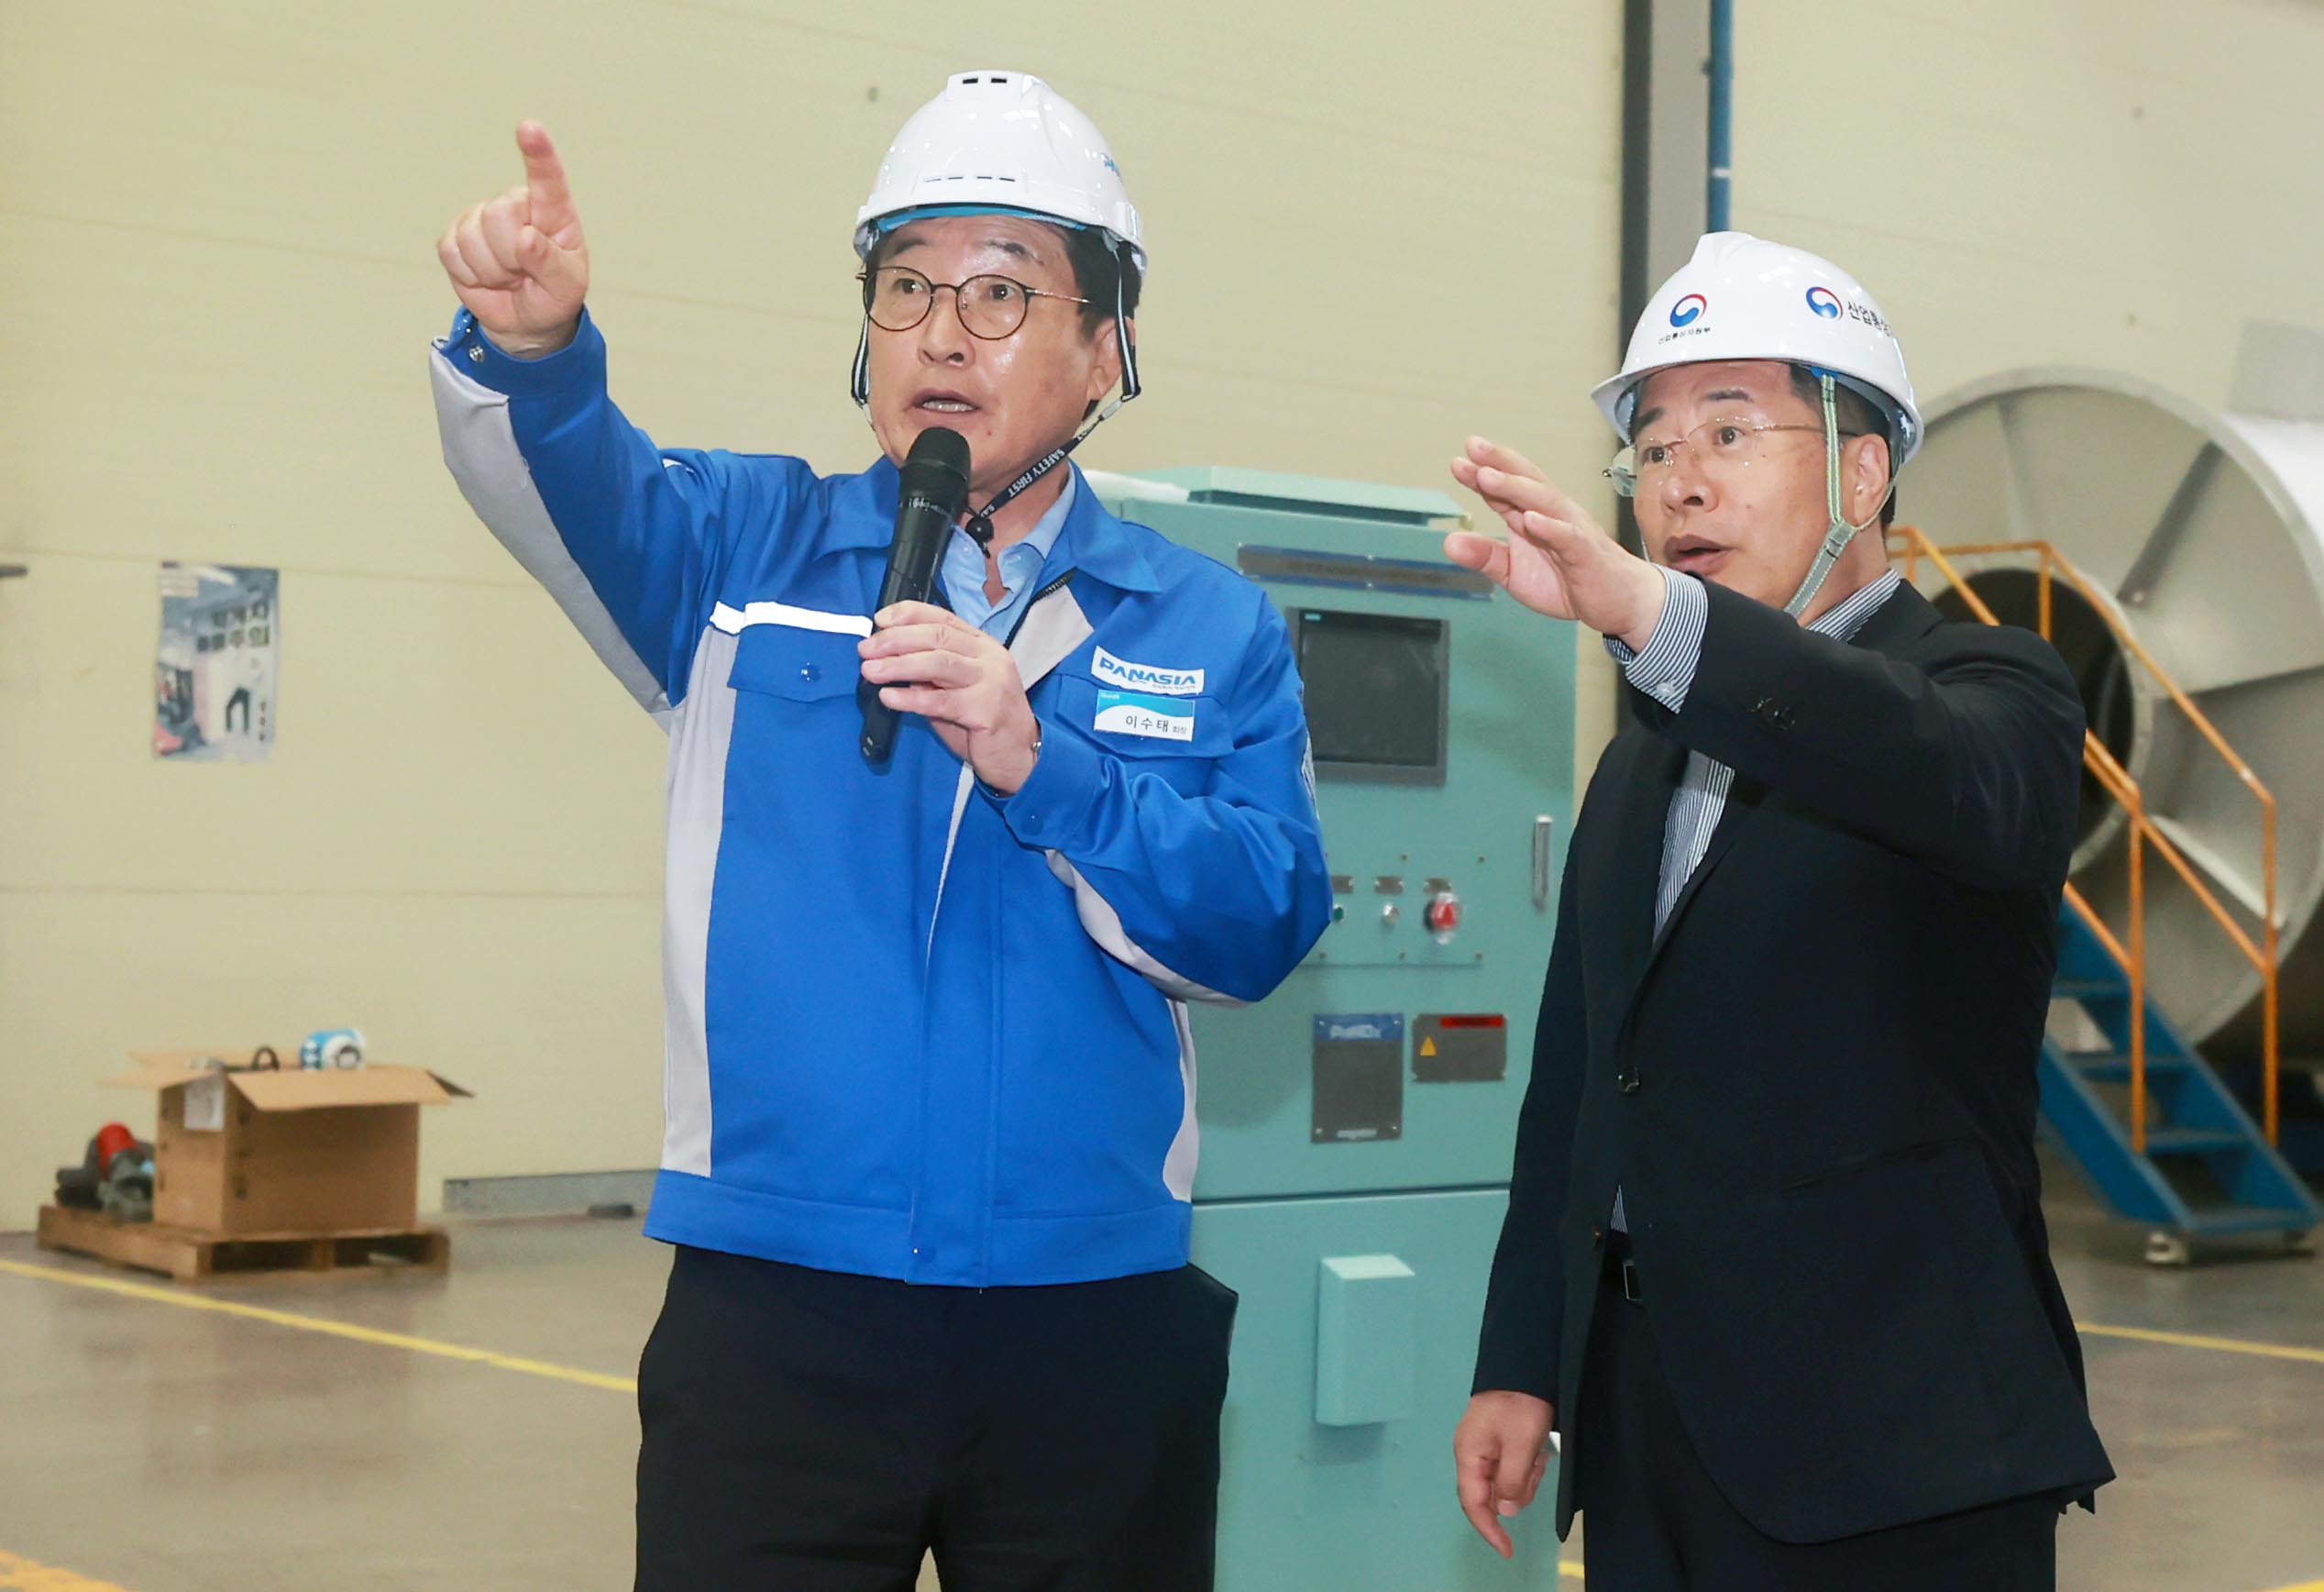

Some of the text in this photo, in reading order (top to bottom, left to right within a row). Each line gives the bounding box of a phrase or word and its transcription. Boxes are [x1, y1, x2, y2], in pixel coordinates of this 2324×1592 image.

[1008, 448, 1065, 498] SAFETY FIRST
[1099, 657, 1196, 685] PANASIA
